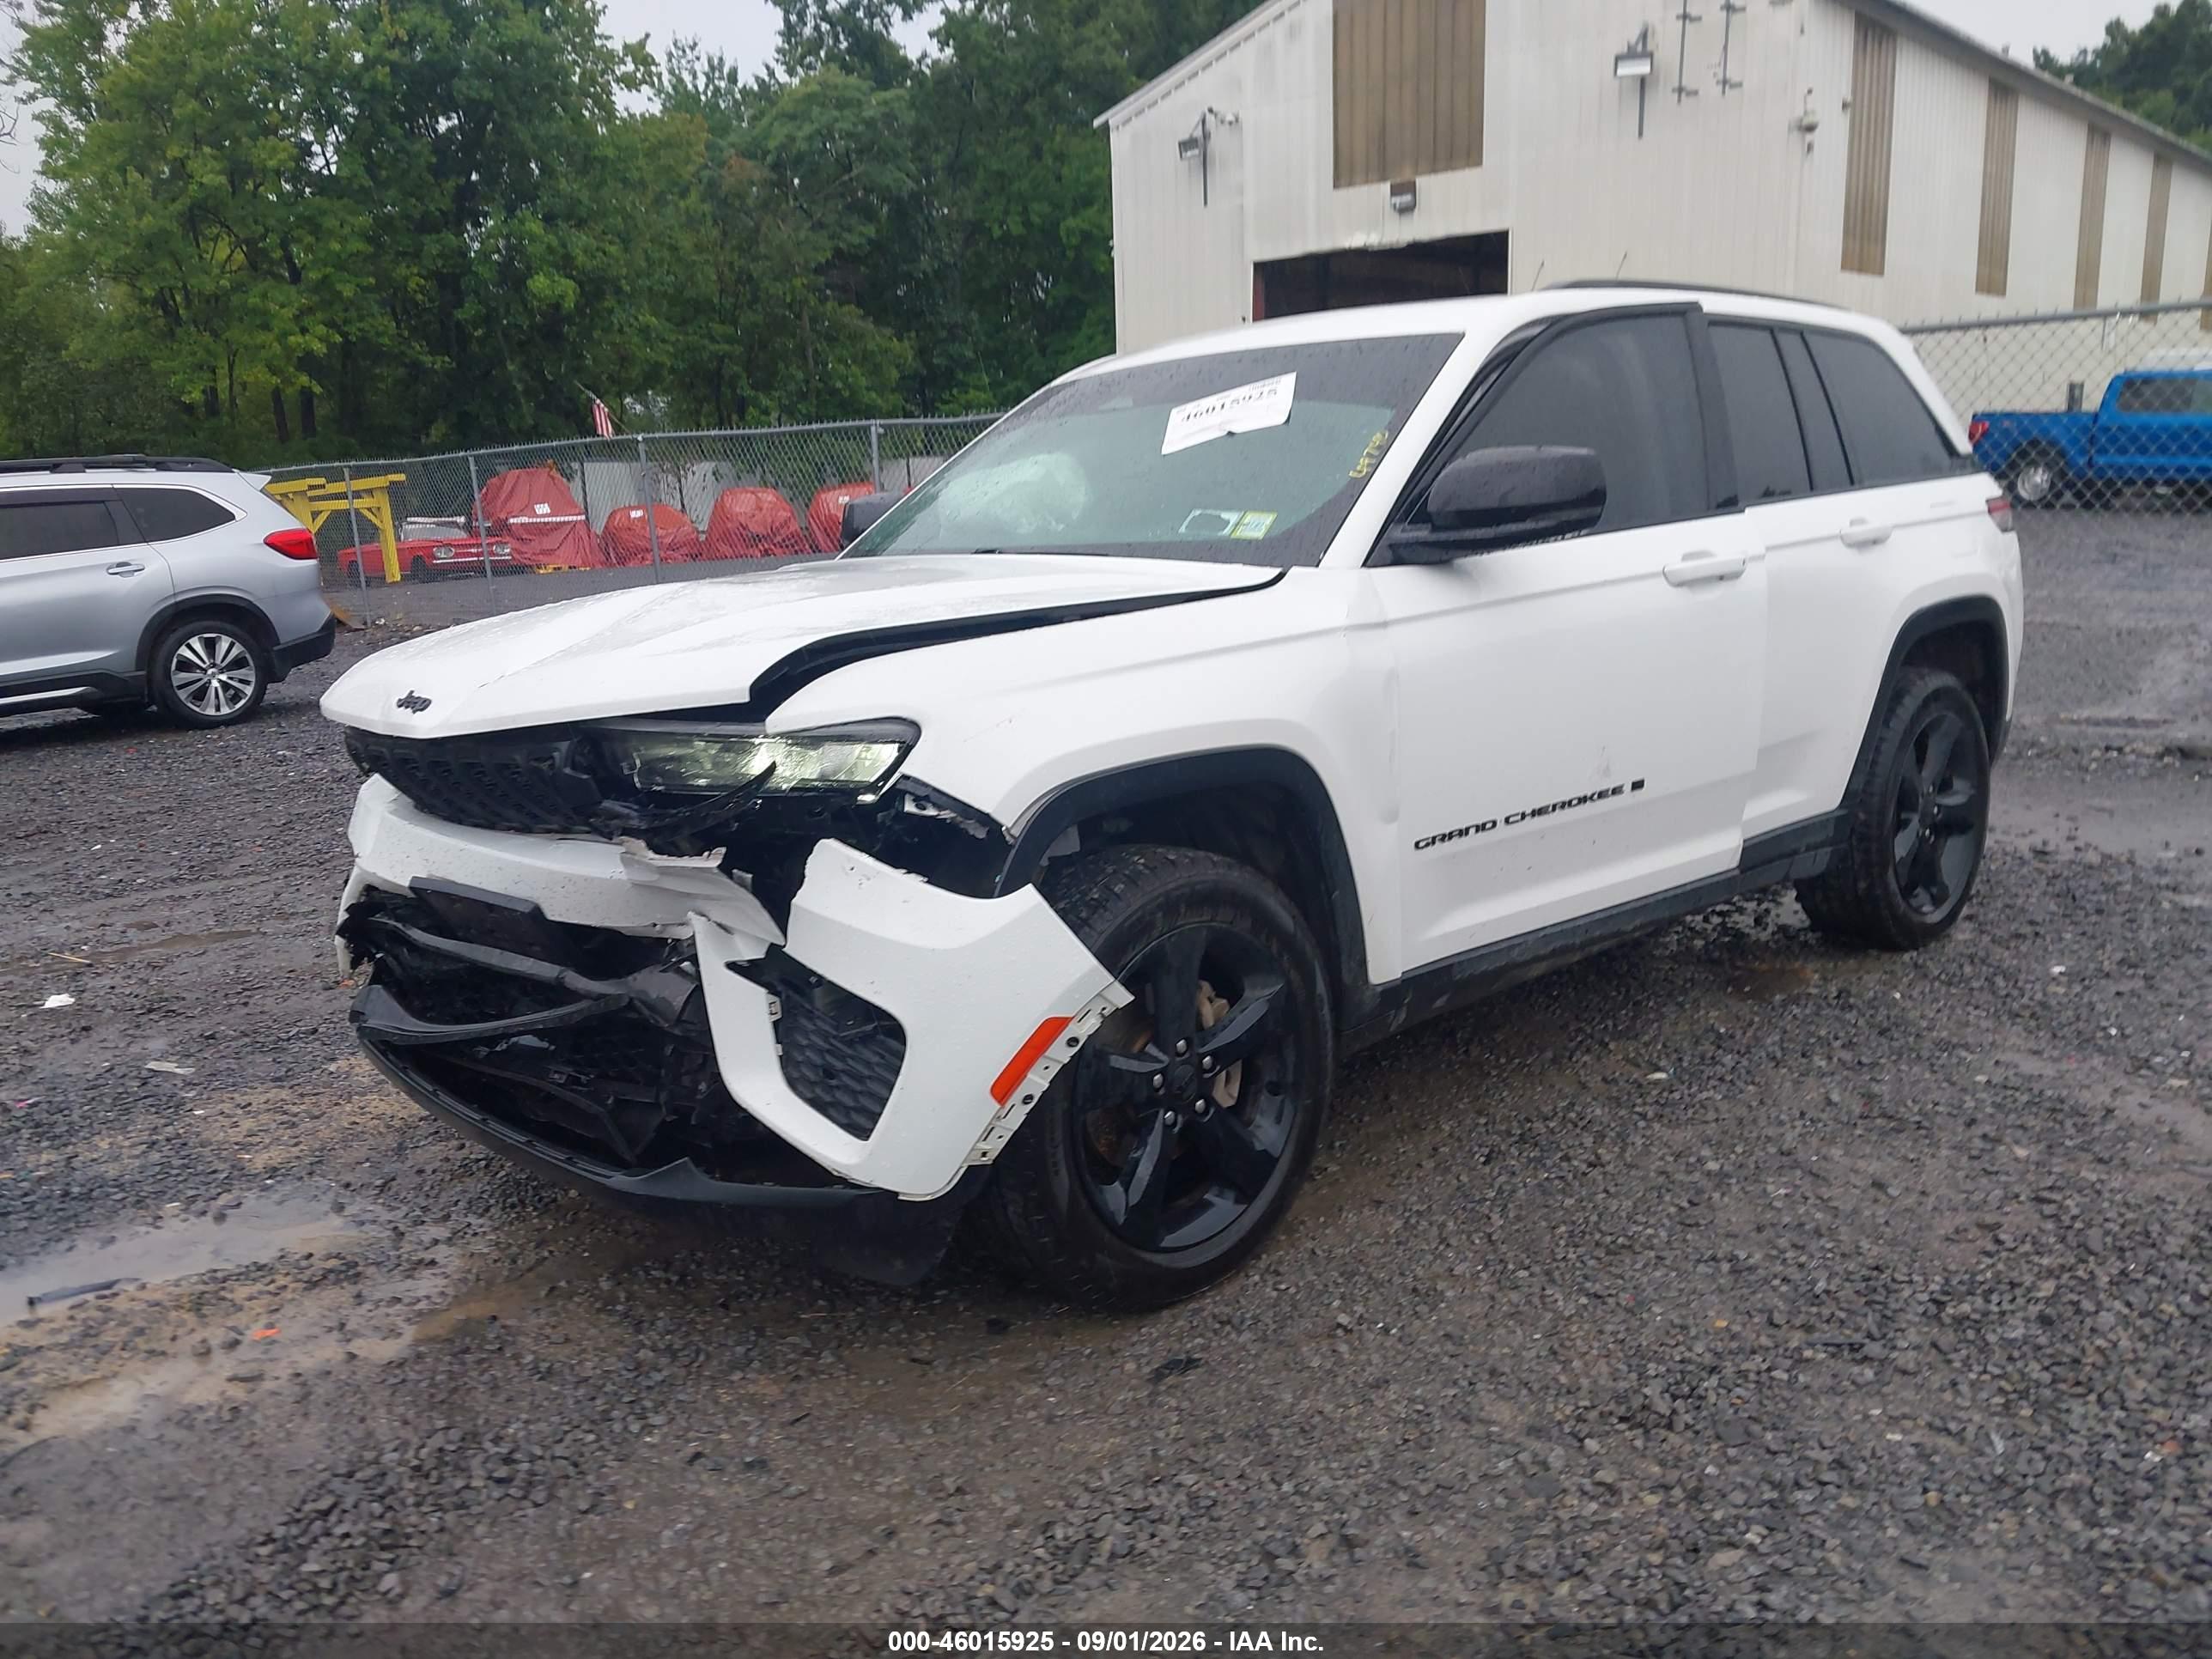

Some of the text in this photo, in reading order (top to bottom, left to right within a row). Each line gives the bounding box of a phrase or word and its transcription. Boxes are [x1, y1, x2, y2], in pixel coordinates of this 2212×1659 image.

[397, 690, 432, 714] Jeep
[1413, 783, 1625, 851] GRAND CHEROKEE
